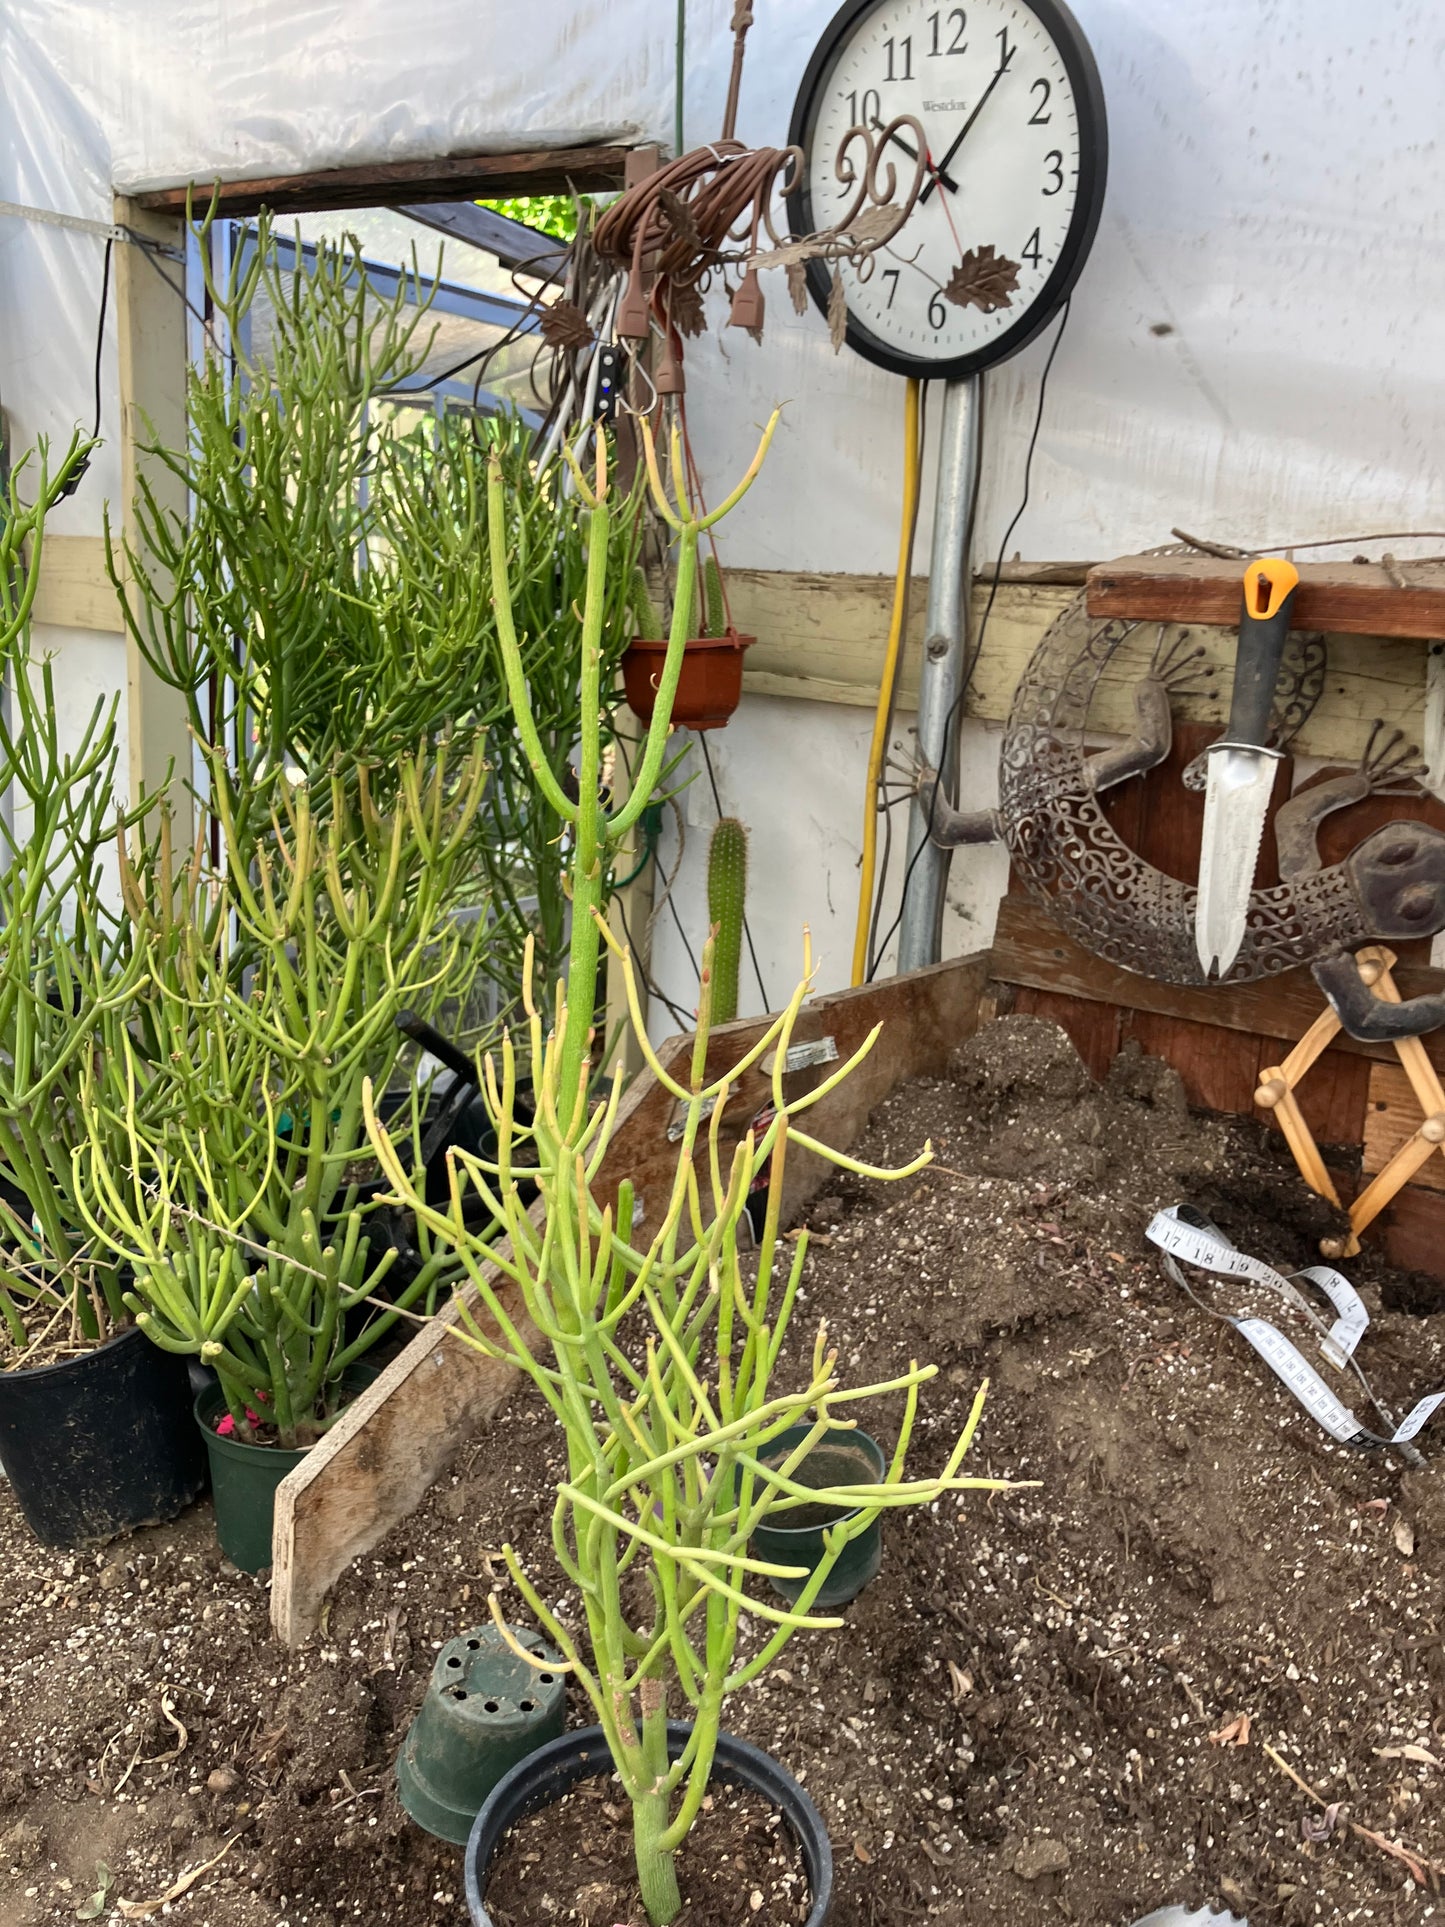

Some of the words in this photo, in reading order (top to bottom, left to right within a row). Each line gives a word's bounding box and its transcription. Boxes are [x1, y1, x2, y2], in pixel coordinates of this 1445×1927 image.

[927, 8, 969, 57] 12
[994, 26, 1011, 74] 1
[882, 35, 916, 82] 11
[845, 89, 881, 132] 10
[1027, 78, 1052, 125] 2
[1041, 150, 1064, 196] 3
[1021, 226, 1043, 270] 4
[881, 269, 901, 310] 7
[928, 290, 946, 330] 6
[1163, 1230, 1182, 1248] 17
[1194, 1247, 1214, 1265] 18
[1229, 1260, 1249, 1273] 19
[1261, 1271, 1283, 1289] 20
